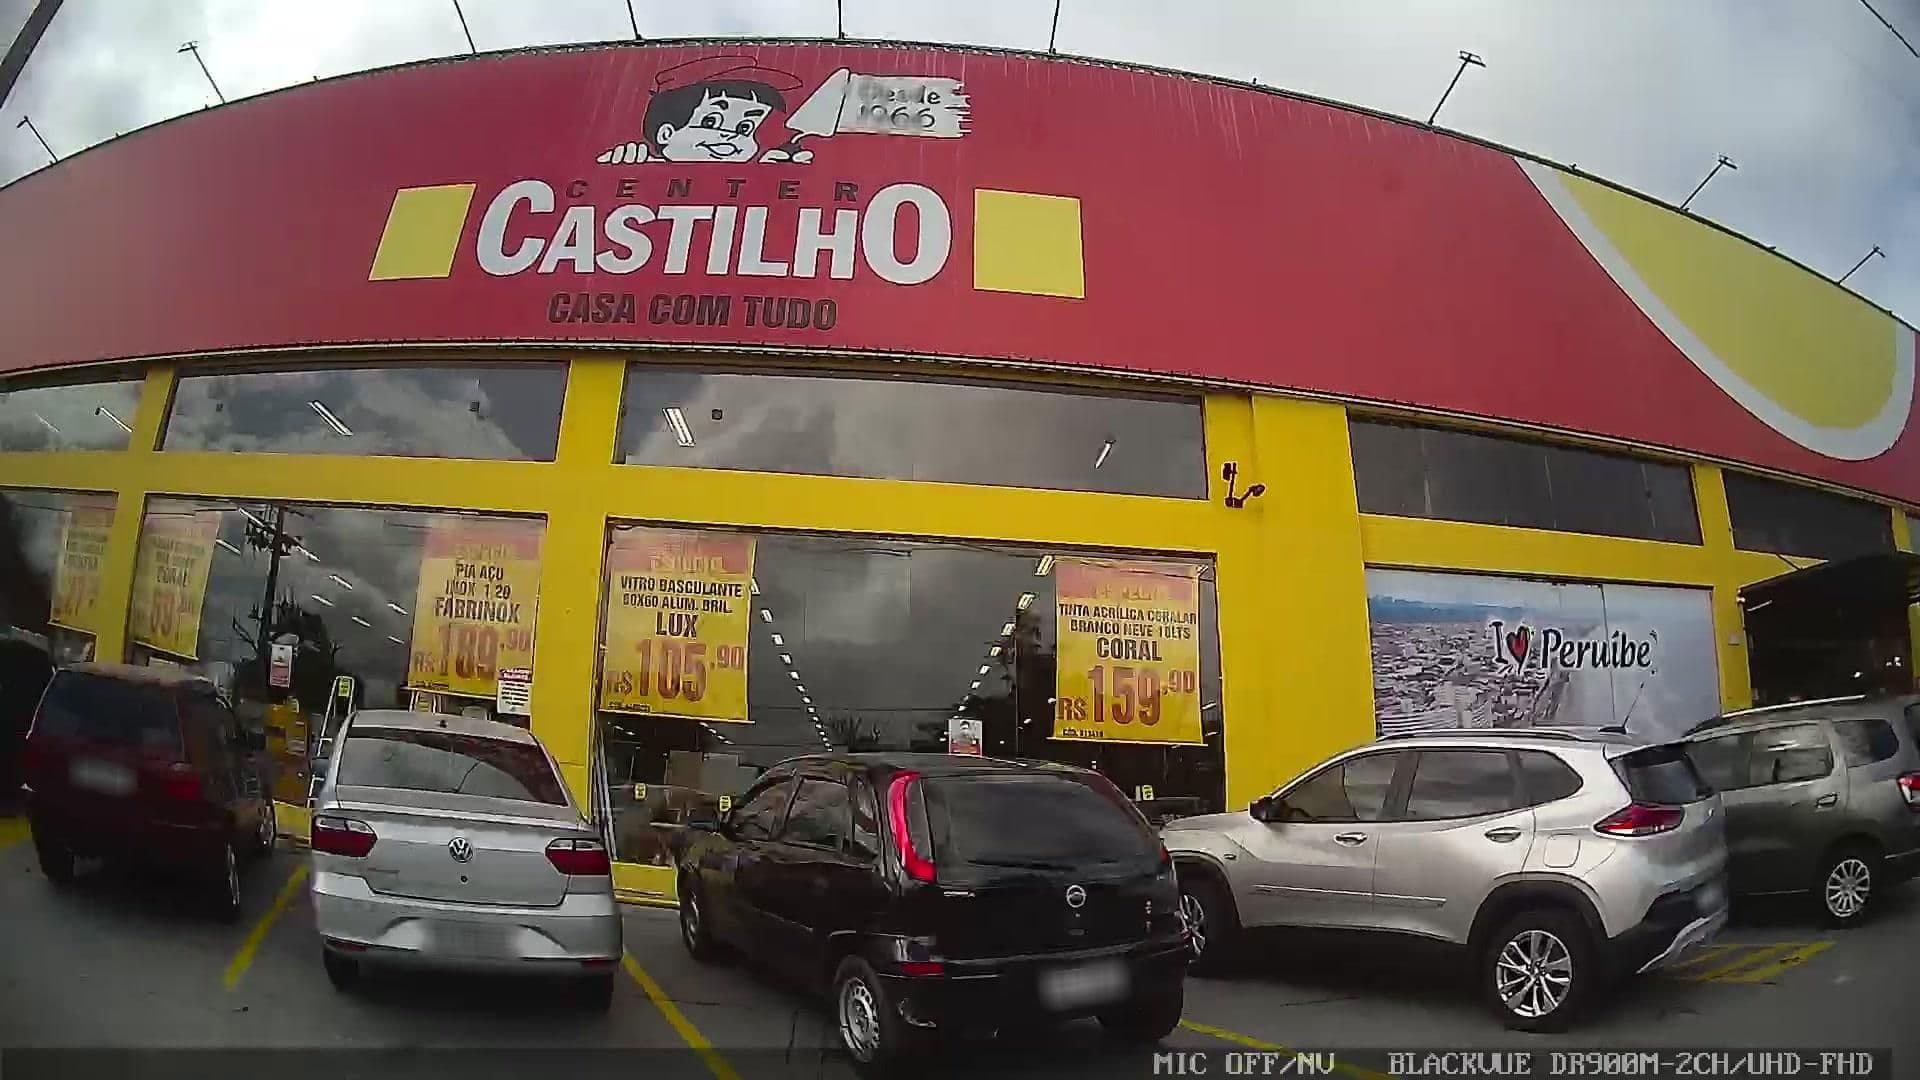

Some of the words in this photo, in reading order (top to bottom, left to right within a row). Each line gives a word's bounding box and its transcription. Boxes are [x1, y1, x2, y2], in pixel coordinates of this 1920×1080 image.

[565, 178, 861, 203] CENTER
[476, 180, 953, 285] CASTILHO
[549, 293, 636, 324] CASA
[648, 294, 732, 328] COM
[742, 296, 839, 331] TUDO
[455, 563, 476, 579] PIA
[621, 575, 655, 591] VITRO
[659, 578, 742, 597] BASCULANTE
[435, 597, 520, 623] FABRINOX
[1059, 604, 1090, 617] TINTA
[656, 612, 697, 638] LUX
[1070, 619, 1120, 634] BRANCO
[1123, 623, 1153, 637] NEVE
[1096, 637, 1162, 662] CORAL
[1489, 621, 1508, 664] I
[1541, 628, 1652, 668] Peruíbe
